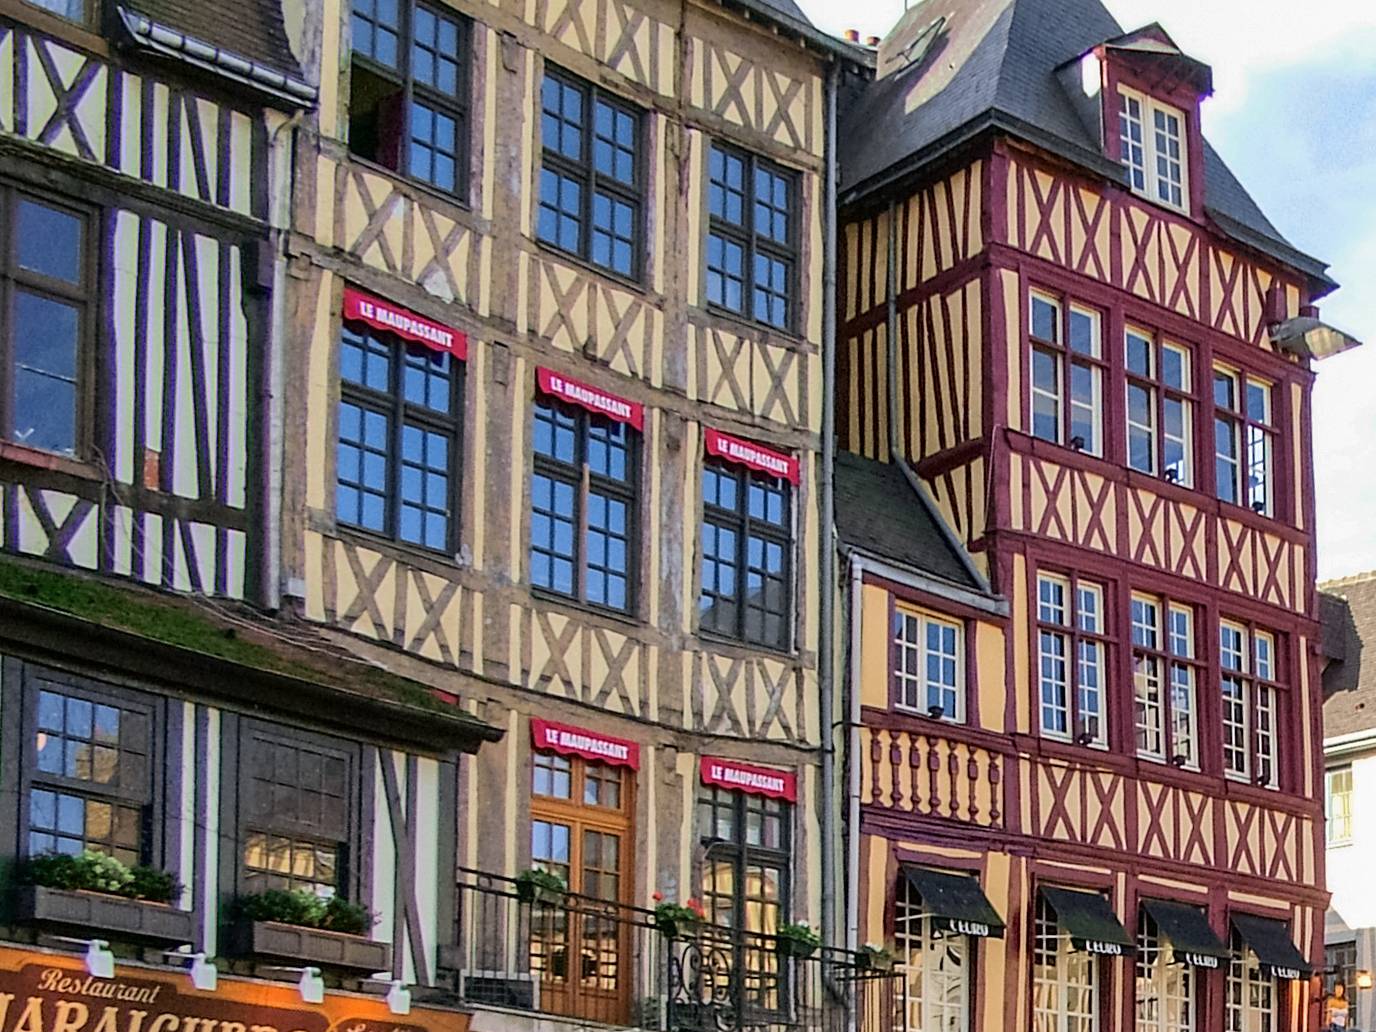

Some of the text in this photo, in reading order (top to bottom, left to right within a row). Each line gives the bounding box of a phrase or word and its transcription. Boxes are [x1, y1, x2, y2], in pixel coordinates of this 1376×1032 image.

[359, 301, 453, 348] LE MAUPASSANT
[550, 376, 632, 418] LE MAUPASSANT
[717, 438, 789, 474] LE MAUPASSANT
[545, 729, 628, 760] LE MAUPASSANT
[711, 765, 785, 792] LE MAUPASSANT
[38, 968, 160, 1004] Restaurant
